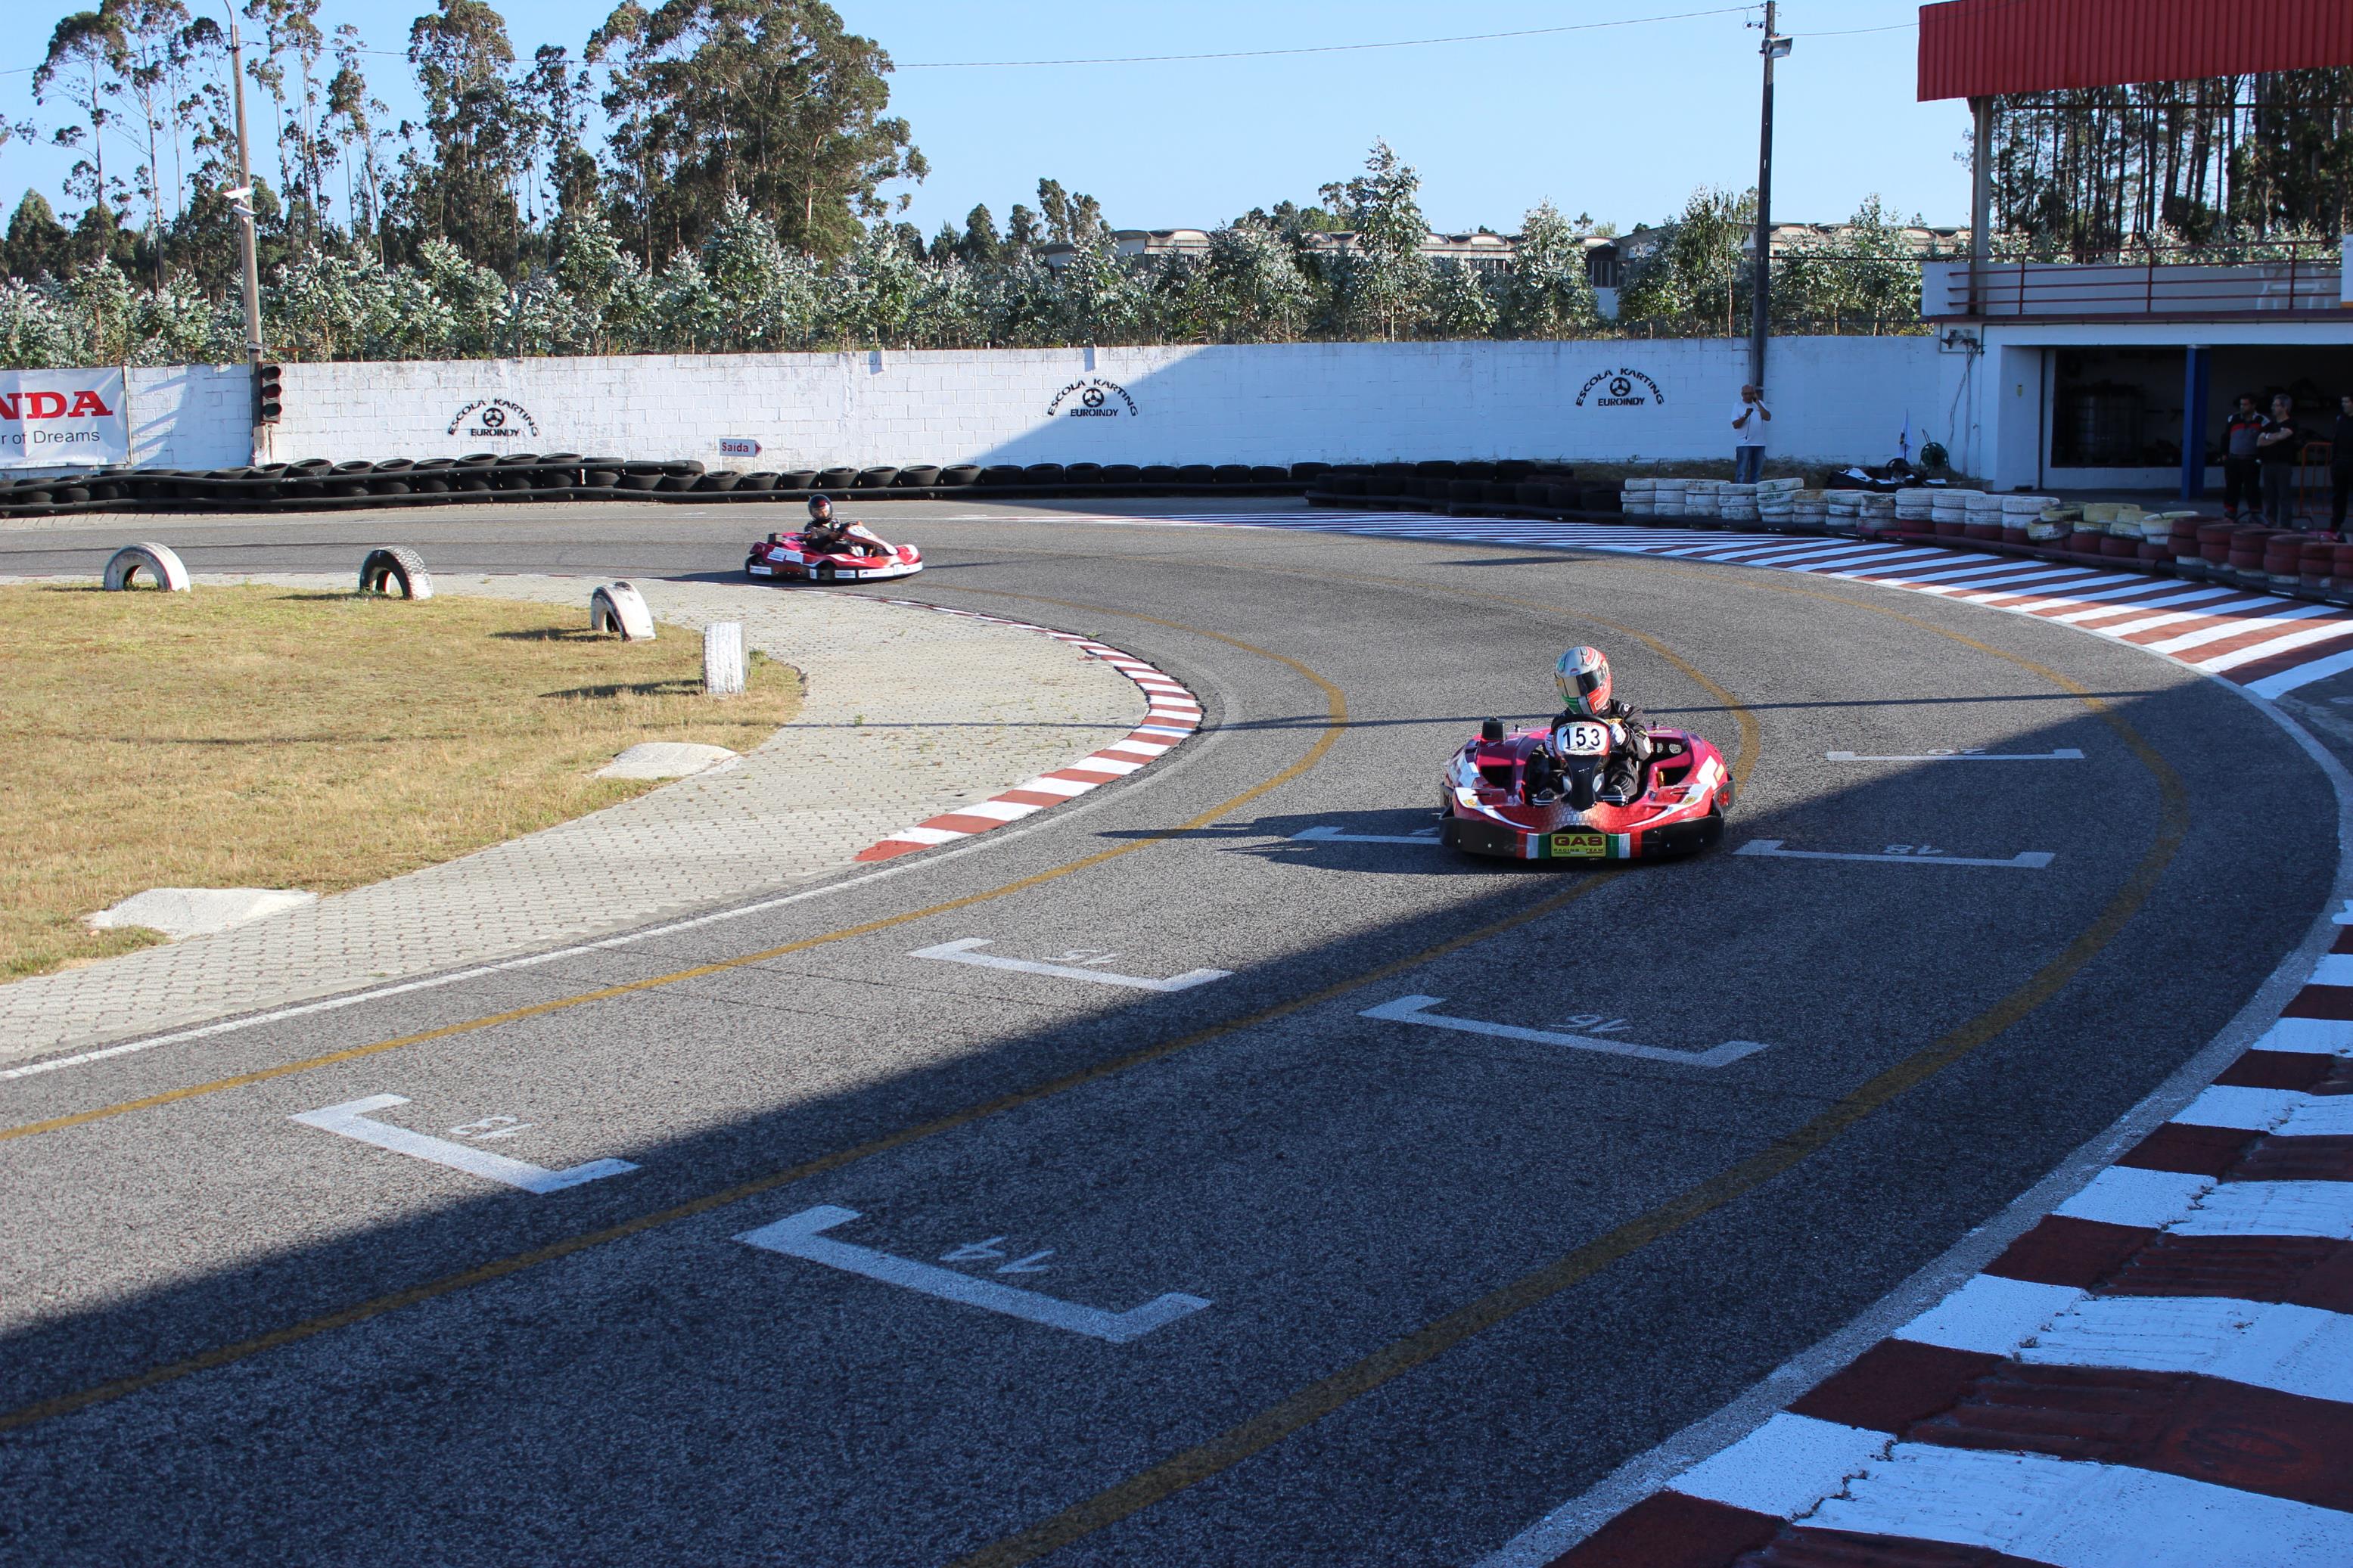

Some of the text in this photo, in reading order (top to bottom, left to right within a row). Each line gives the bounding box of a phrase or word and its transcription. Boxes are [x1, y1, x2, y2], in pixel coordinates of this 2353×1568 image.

[1575, 368, 1665, 407] ESCOLA KARTING
[1047, 378, 1139, 416] ESCOLA KARTING
[1598, 397, 1645, 406] EUROINDY
[448, 398, 540, 436] ESCOLA KARTING
[1071, 408, 1119, 417] EUROINDY
[11, 432, 28, 445] of
[34, 430, 101, 443] Dreams
[471, 428, 520, 436] EUROINDY
[1562, 727, 1601, 747] 153
